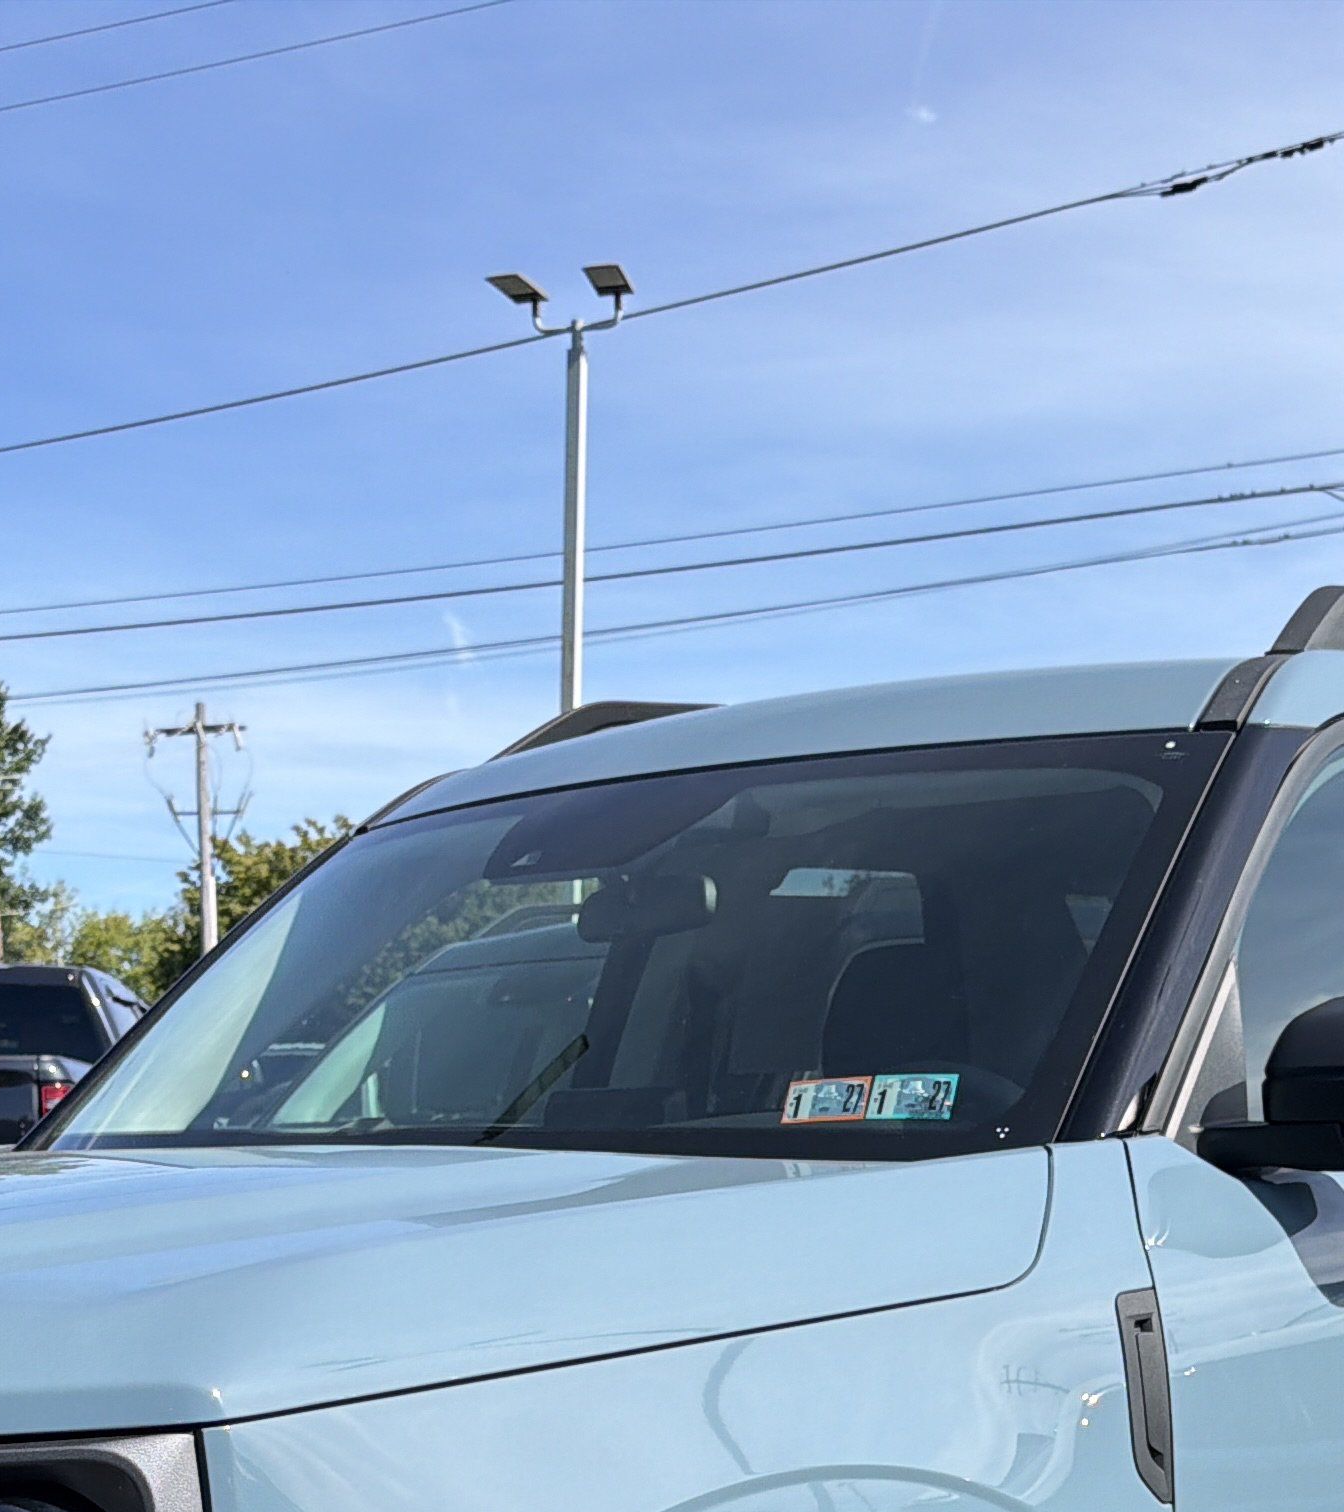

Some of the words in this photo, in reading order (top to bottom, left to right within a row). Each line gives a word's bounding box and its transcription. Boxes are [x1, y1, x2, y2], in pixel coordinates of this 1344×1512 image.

[793, 1093, 803, 1118] 1
[843, 1084, 864, 1114] 27
[877, 1089, 887, 1116] 1
[929, 1080, 951, 1112] 27
